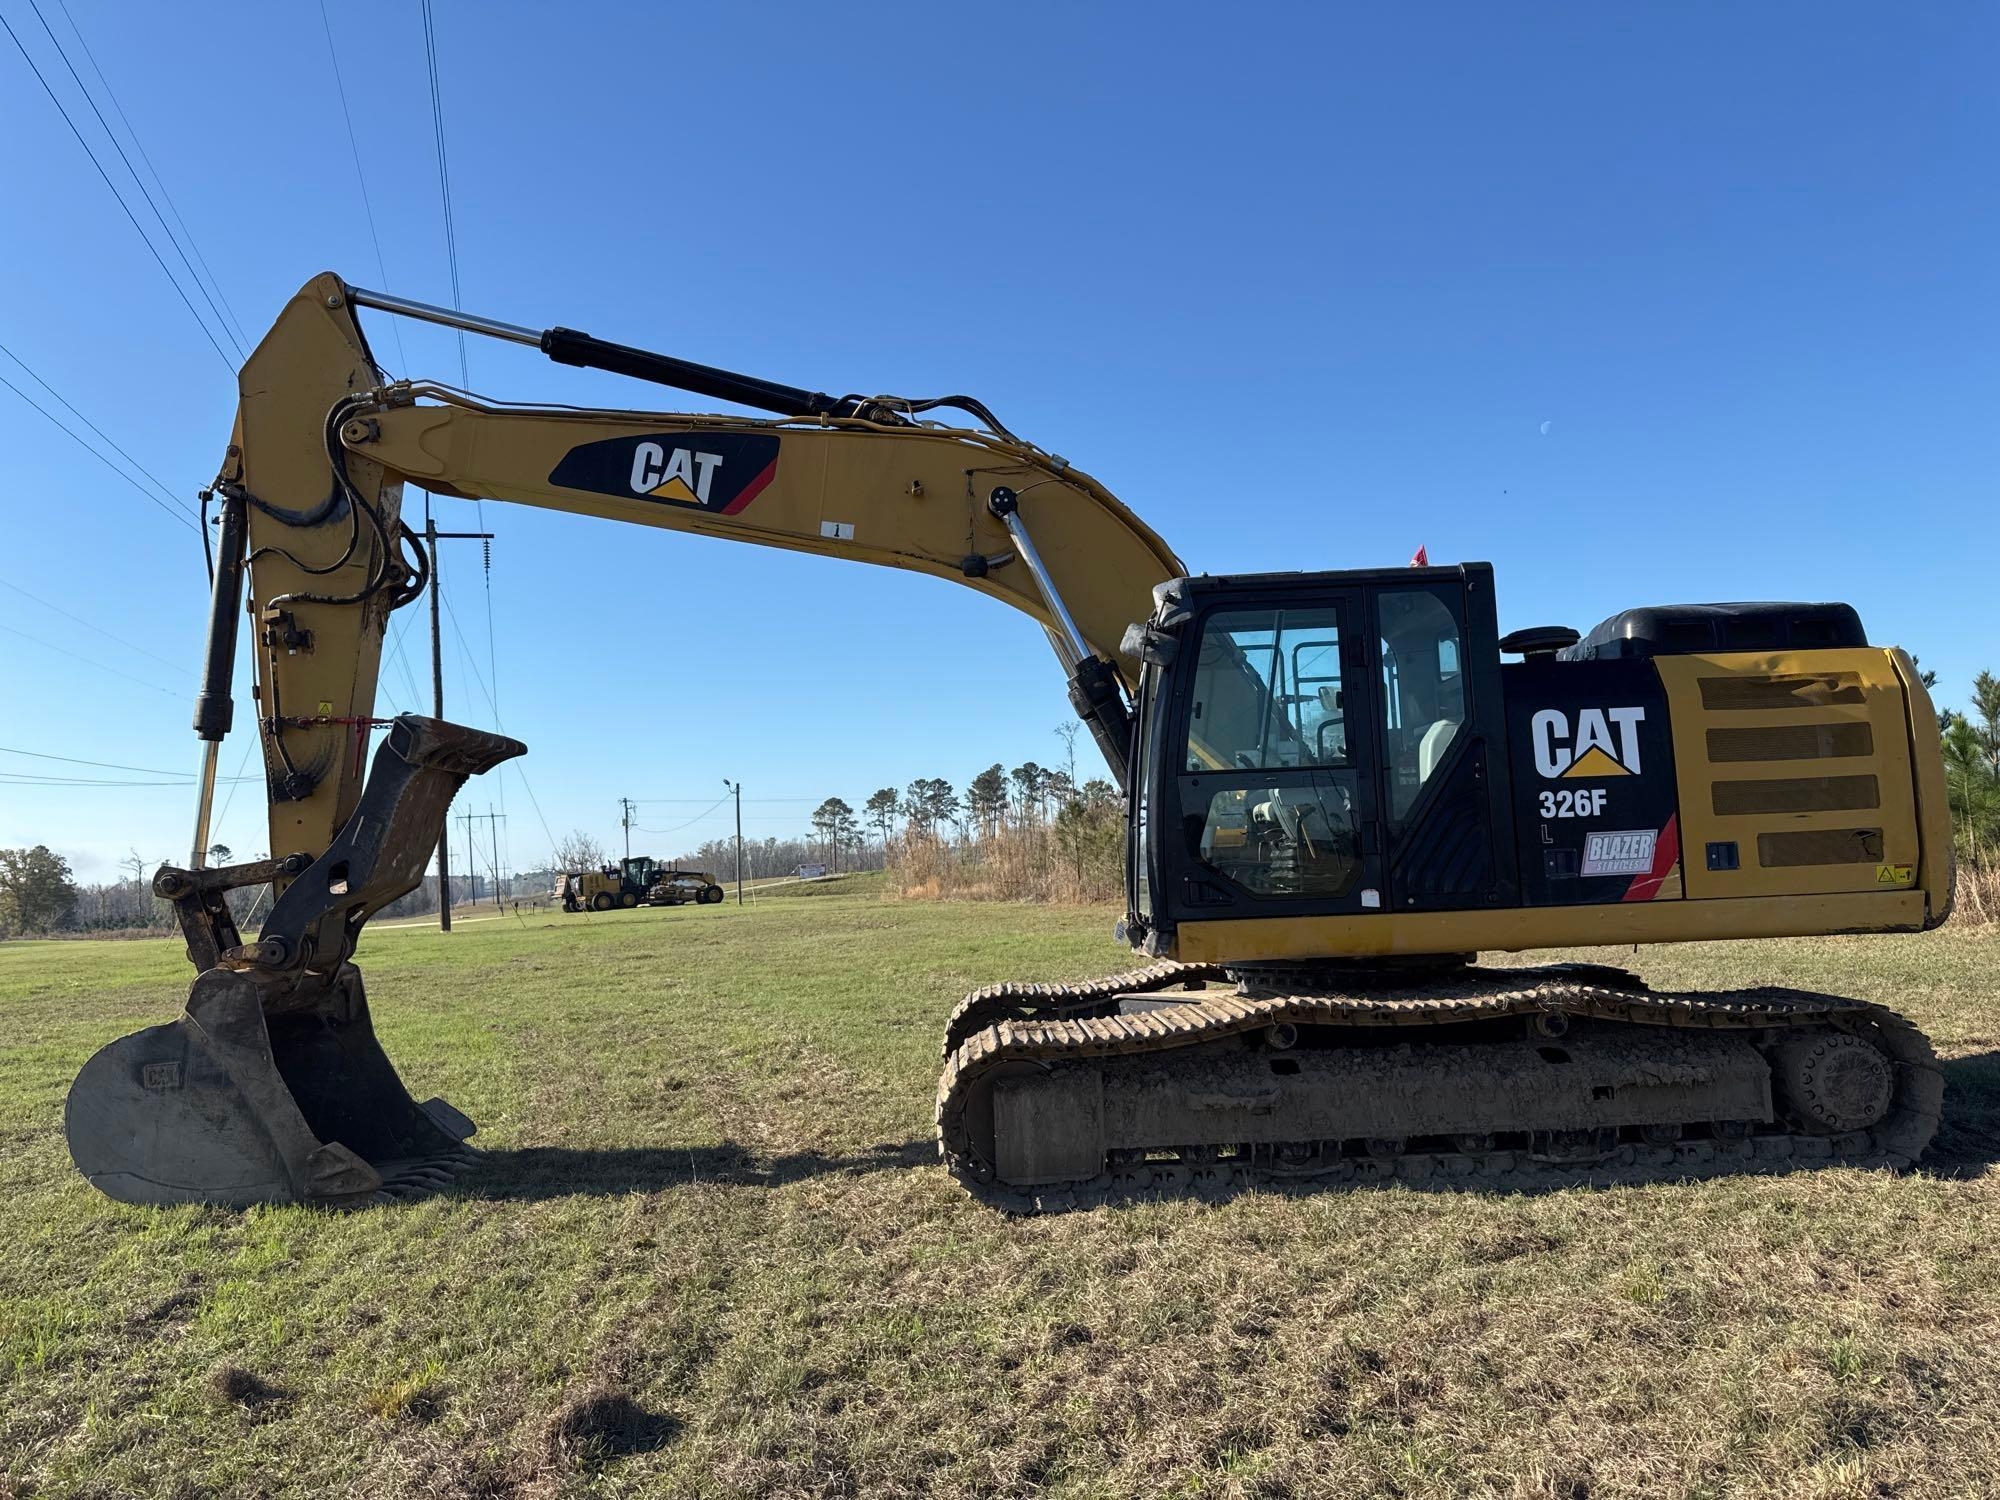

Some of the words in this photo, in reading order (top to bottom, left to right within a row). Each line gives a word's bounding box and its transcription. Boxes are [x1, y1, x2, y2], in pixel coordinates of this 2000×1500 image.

[630, 442, 723, 505] CAT
[1531, 706, 1645, 779] CAT
[1539, 789, 1607, 818] 326F
[1541, 824, 1554, 844] L
[1588, 835, 1653, 861] BLAZER
[1596, 860, 1641, 872] SERVICES
